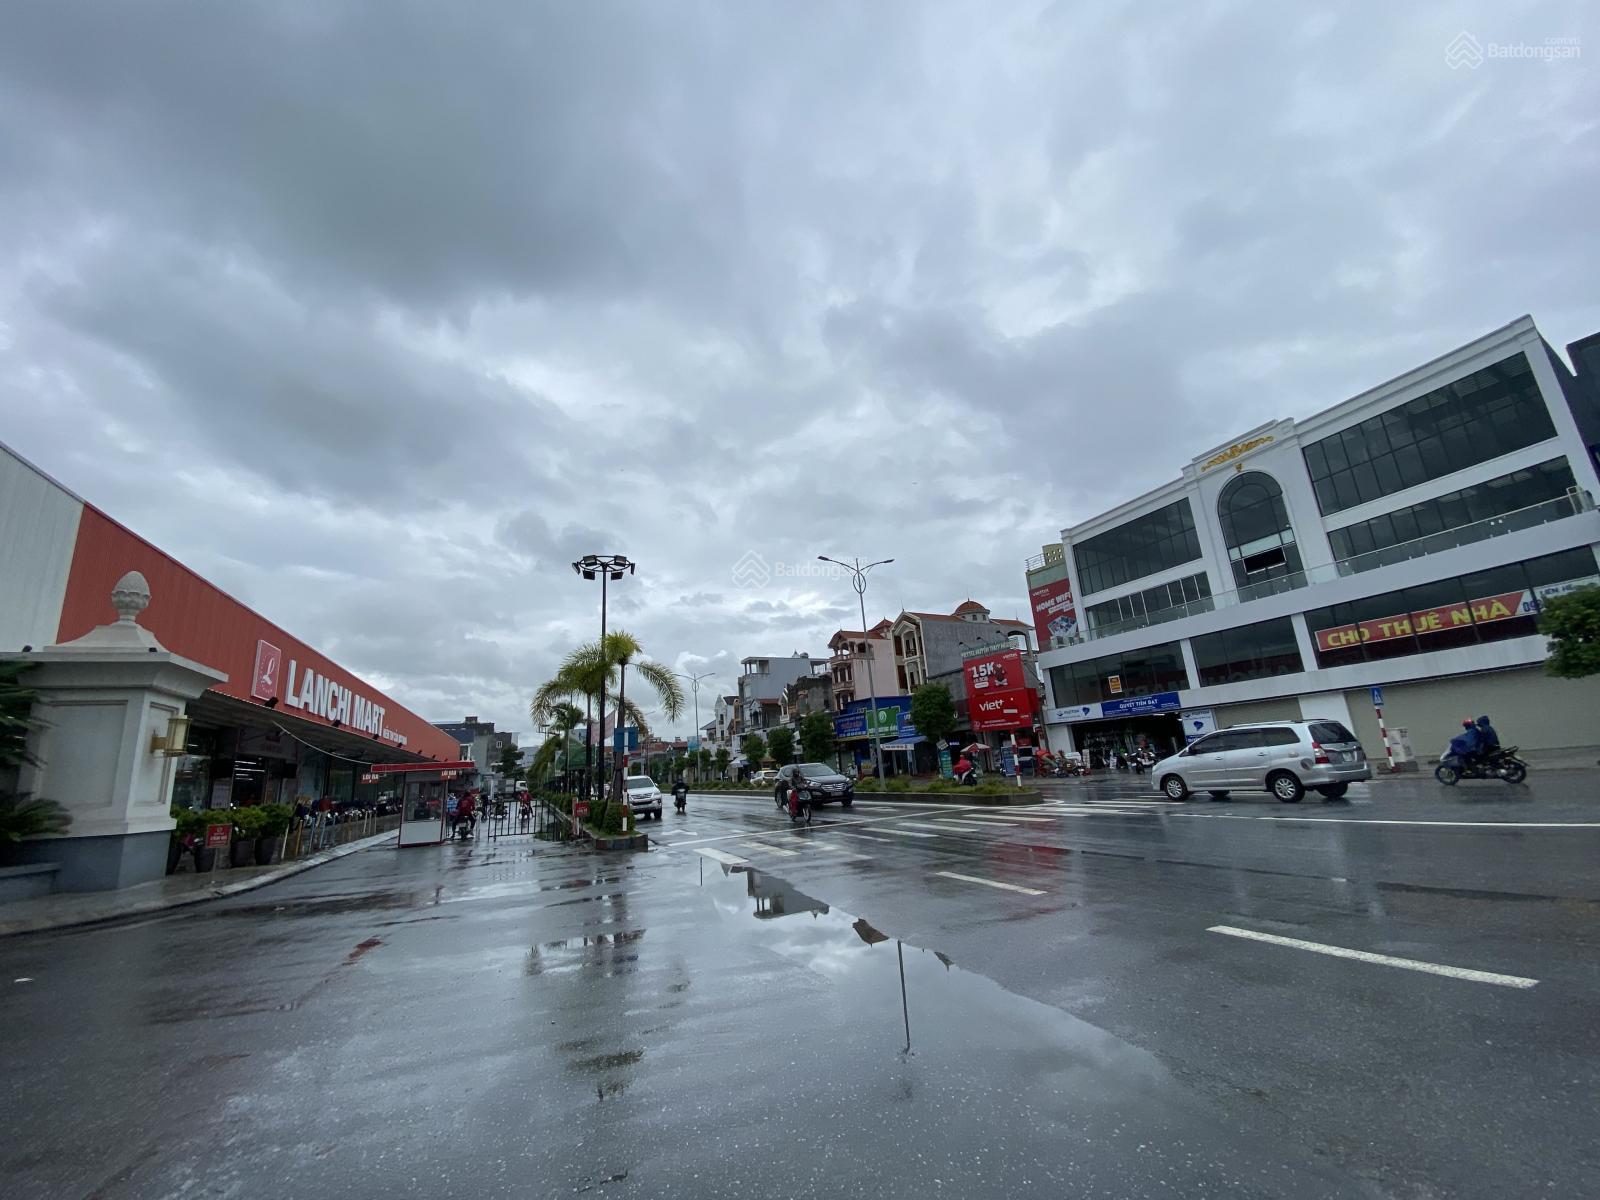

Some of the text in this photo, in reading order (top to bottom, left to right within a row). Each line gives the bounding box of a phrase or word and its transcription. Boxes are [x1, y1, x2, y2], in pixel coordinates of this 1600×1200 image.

[1036, 598, 1055, 613] HOME
[1327, 628, 1370, 648] CHO
[1450, 599, 1511, 625] NHÀ
[971, 661, 995, 678] 15K
[285, 659, 385, 737] LANCHI MART
